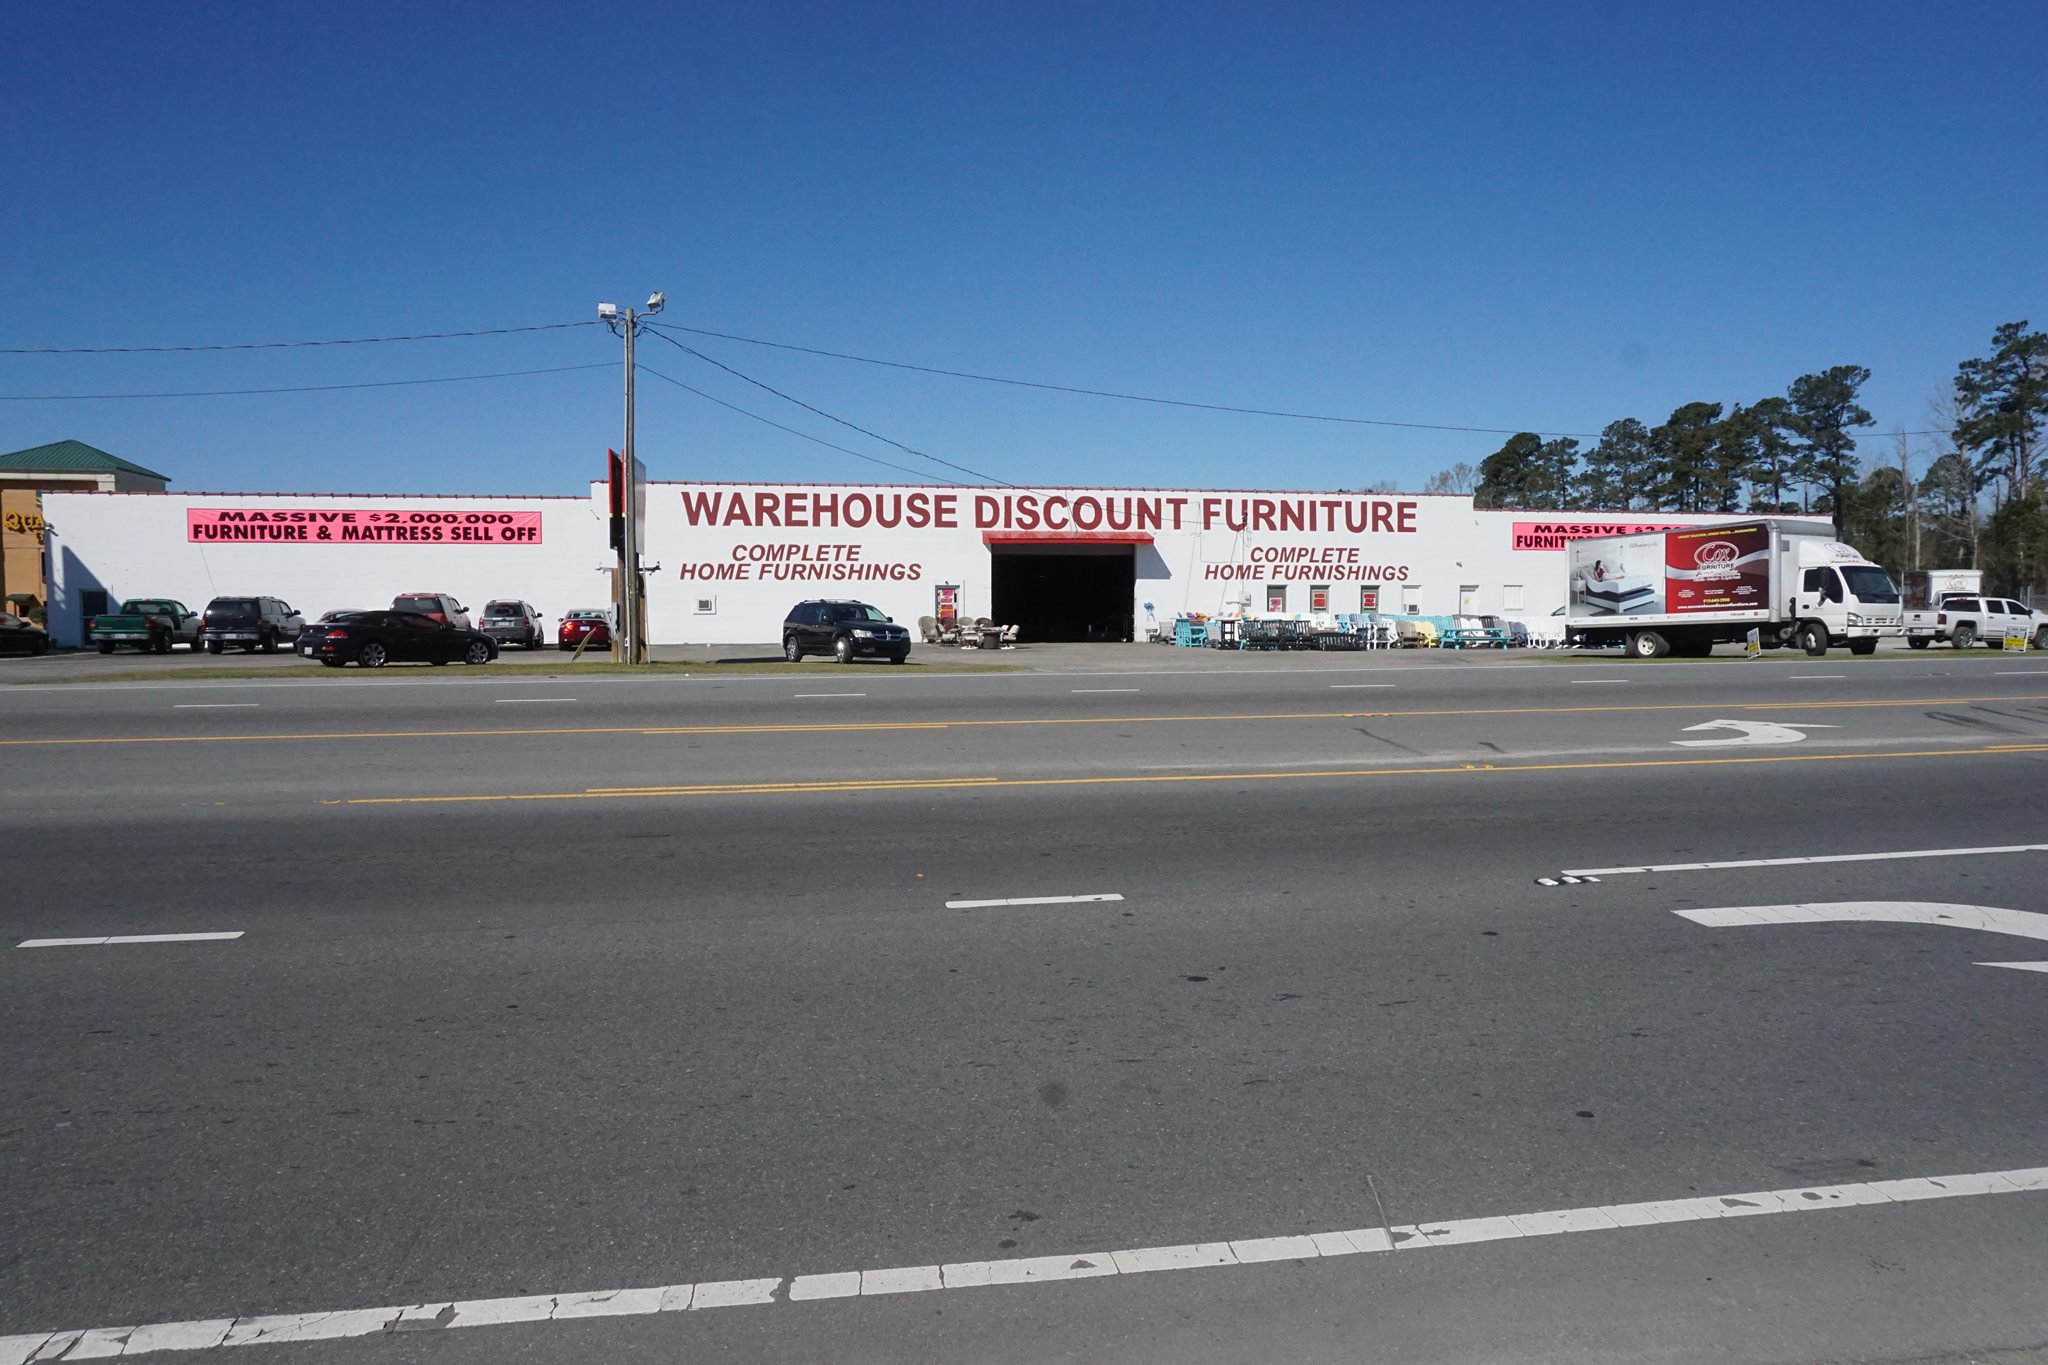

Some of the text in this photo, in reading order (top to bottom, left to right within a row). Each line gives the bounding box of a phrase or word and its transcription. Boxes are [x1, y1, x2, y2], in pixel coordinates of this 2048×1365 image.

[218, 511, 514, 524] MASSIVE $2,000,000
[681, 491, 1418, 534] WAREHOUSE DISCOUNT FURNITURE
[192, 524, 537, 541] FURNITURE & MATTRESS SELL OFF
[1533, 525, 1626, 534] MASSIVE
[732, 543, 862, 562] COMPLETE
[1250, 546, 1360, 564] COMPLETE
[1702, 544, 1731, 563] Cox
[680, 563, 922, 581] HOME FURNISHINGS
[1204, 564, 1409, 581] HOME FURNISHINGS
[1696, 562, 1735, 571] FURNITURE
